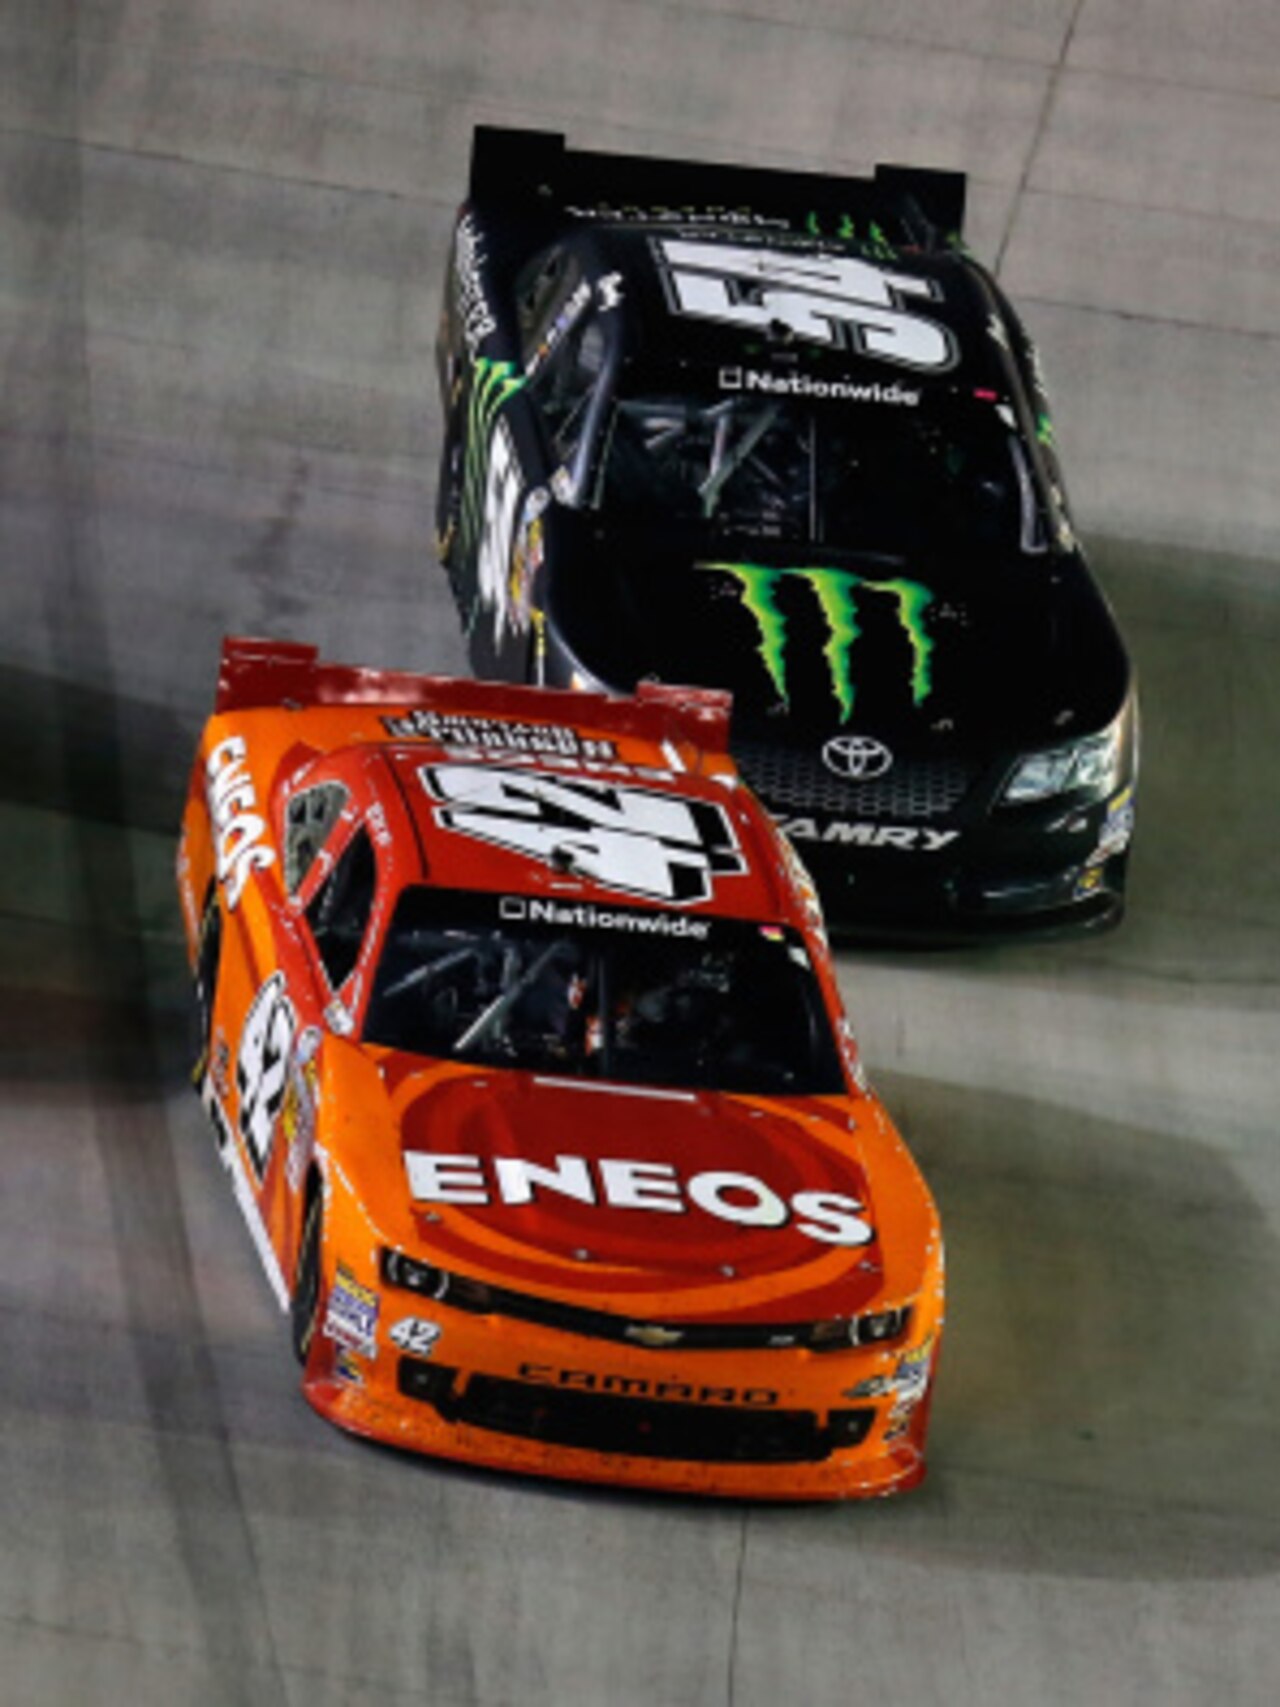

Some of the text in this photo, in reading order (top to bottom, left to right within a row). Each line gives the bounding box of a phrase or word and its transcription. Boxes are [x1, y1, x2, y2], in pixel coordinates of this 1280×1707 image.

[646, 236, 962, 375] 54
[745, 368, 921, 406] Nationwide
[206, 735, 277, 913] ENEOS
[416, 764, 750, 905] 42
[529, 900, 710, 941] Nationwide
[236, 968, 298, 1189] 42
[404, 1149, 876, 1249] ENEOS
[389, 1314, 443, 1357] 42
[518, 1362, 779, 1405] CAMARO
